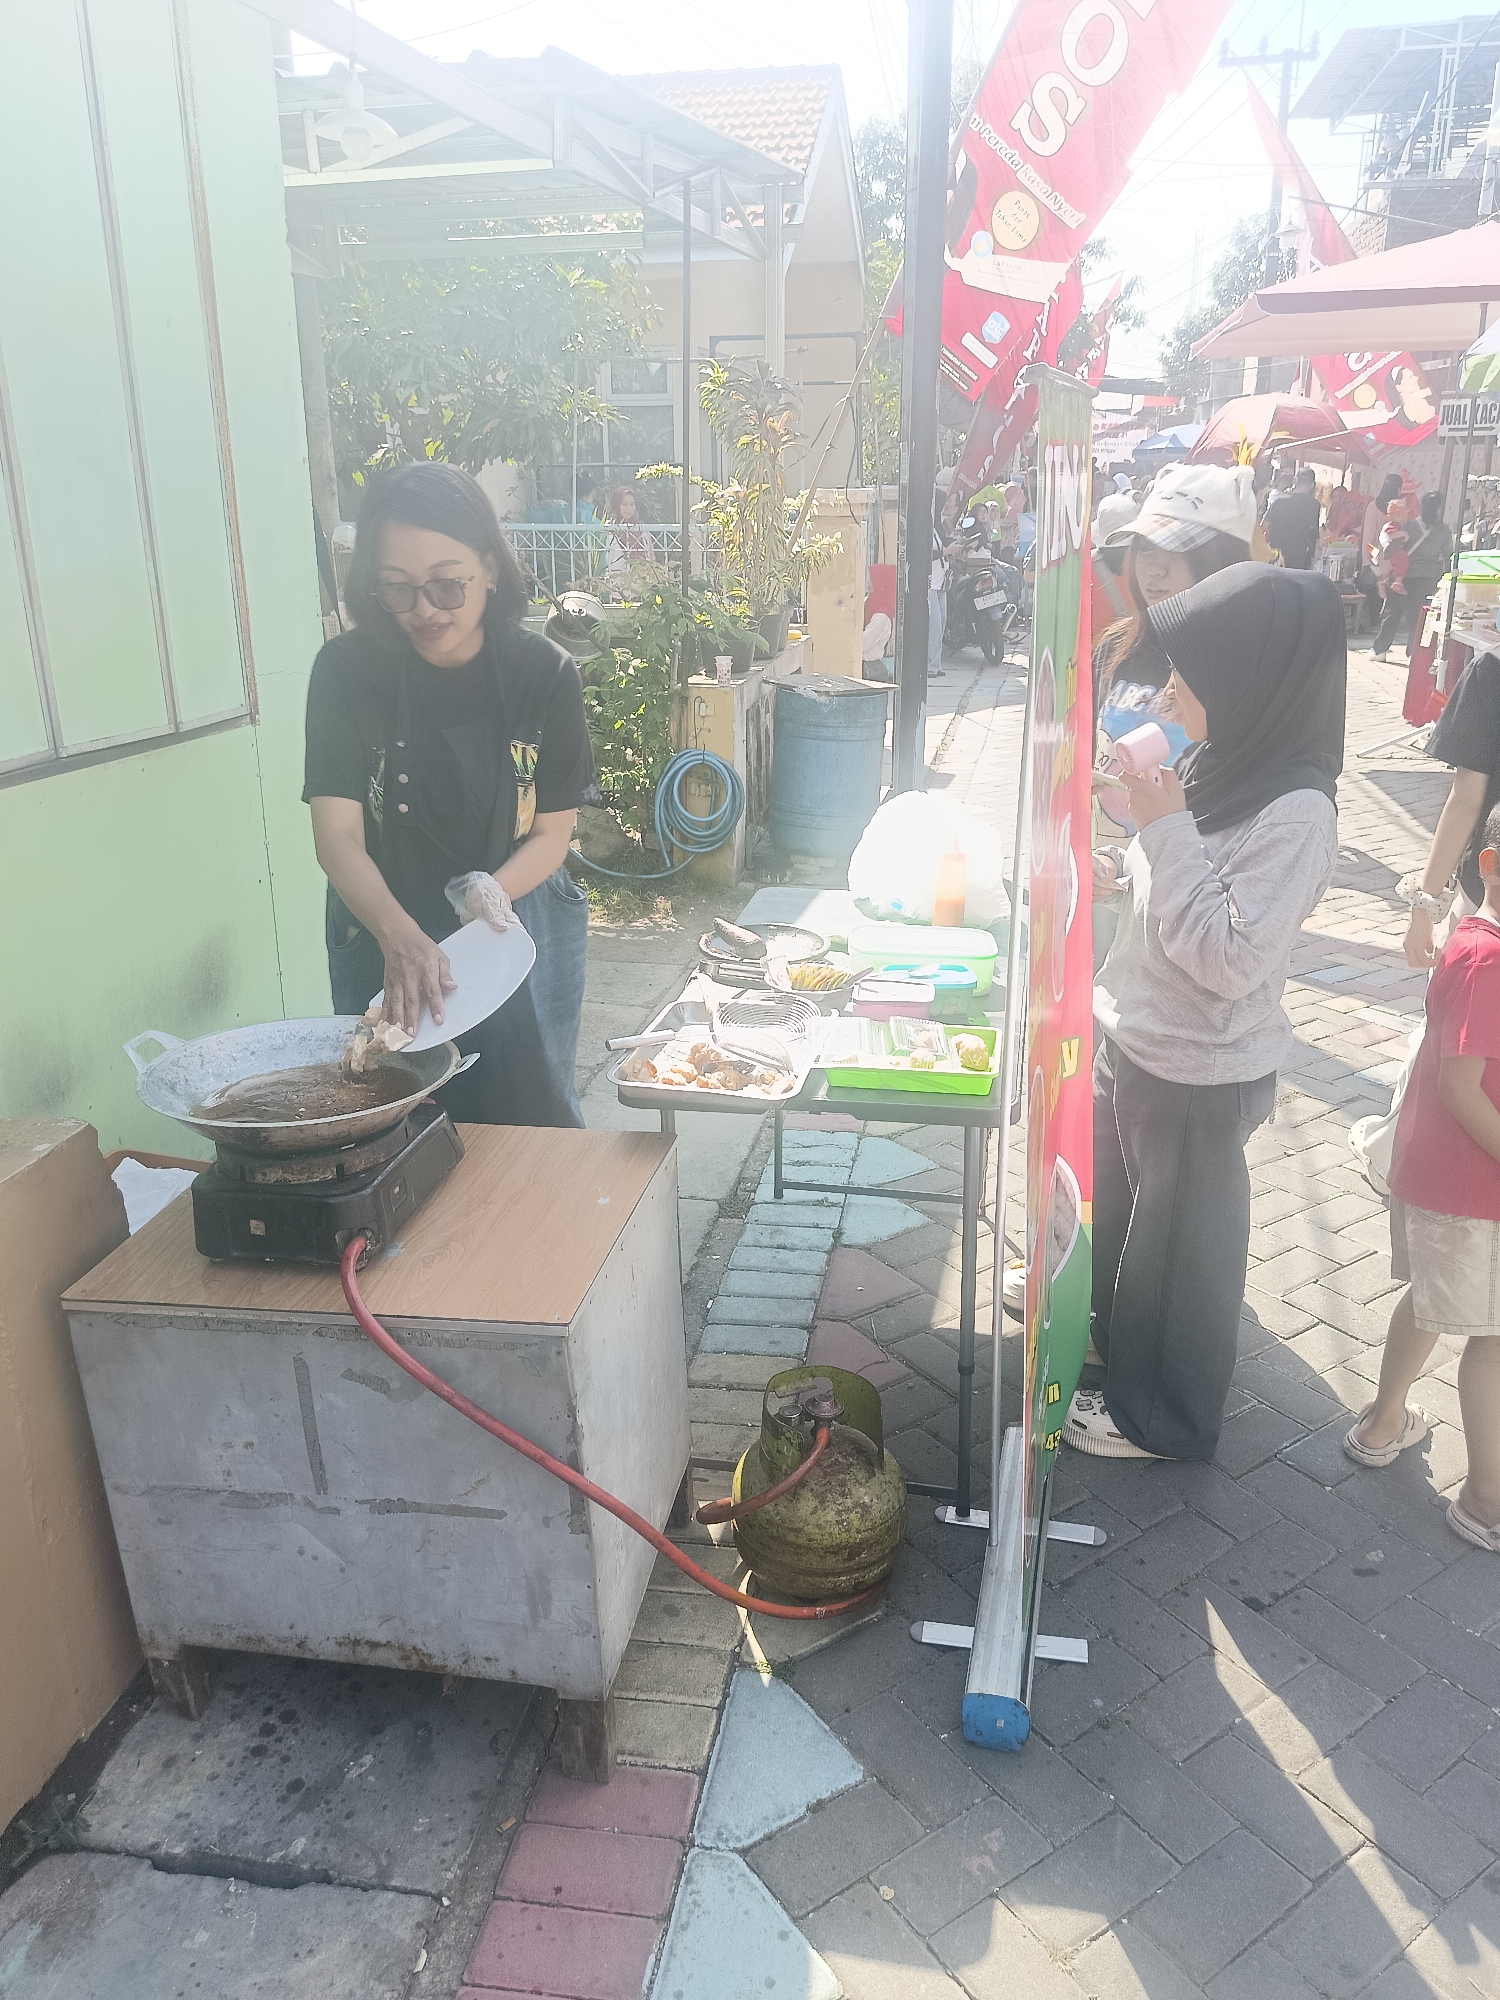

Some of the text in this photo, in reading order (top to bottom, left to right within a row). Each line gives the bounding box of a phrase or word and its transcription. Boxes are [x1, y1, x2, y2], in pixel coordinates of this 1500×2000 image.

[1009, 0, 1160, 157] OS
[979, 125, 1085, 226] Pereda Rasa Nyeri
[1013, 199, 1031, 219] Panas
[1440, 404, 1468, 426] JUAL
